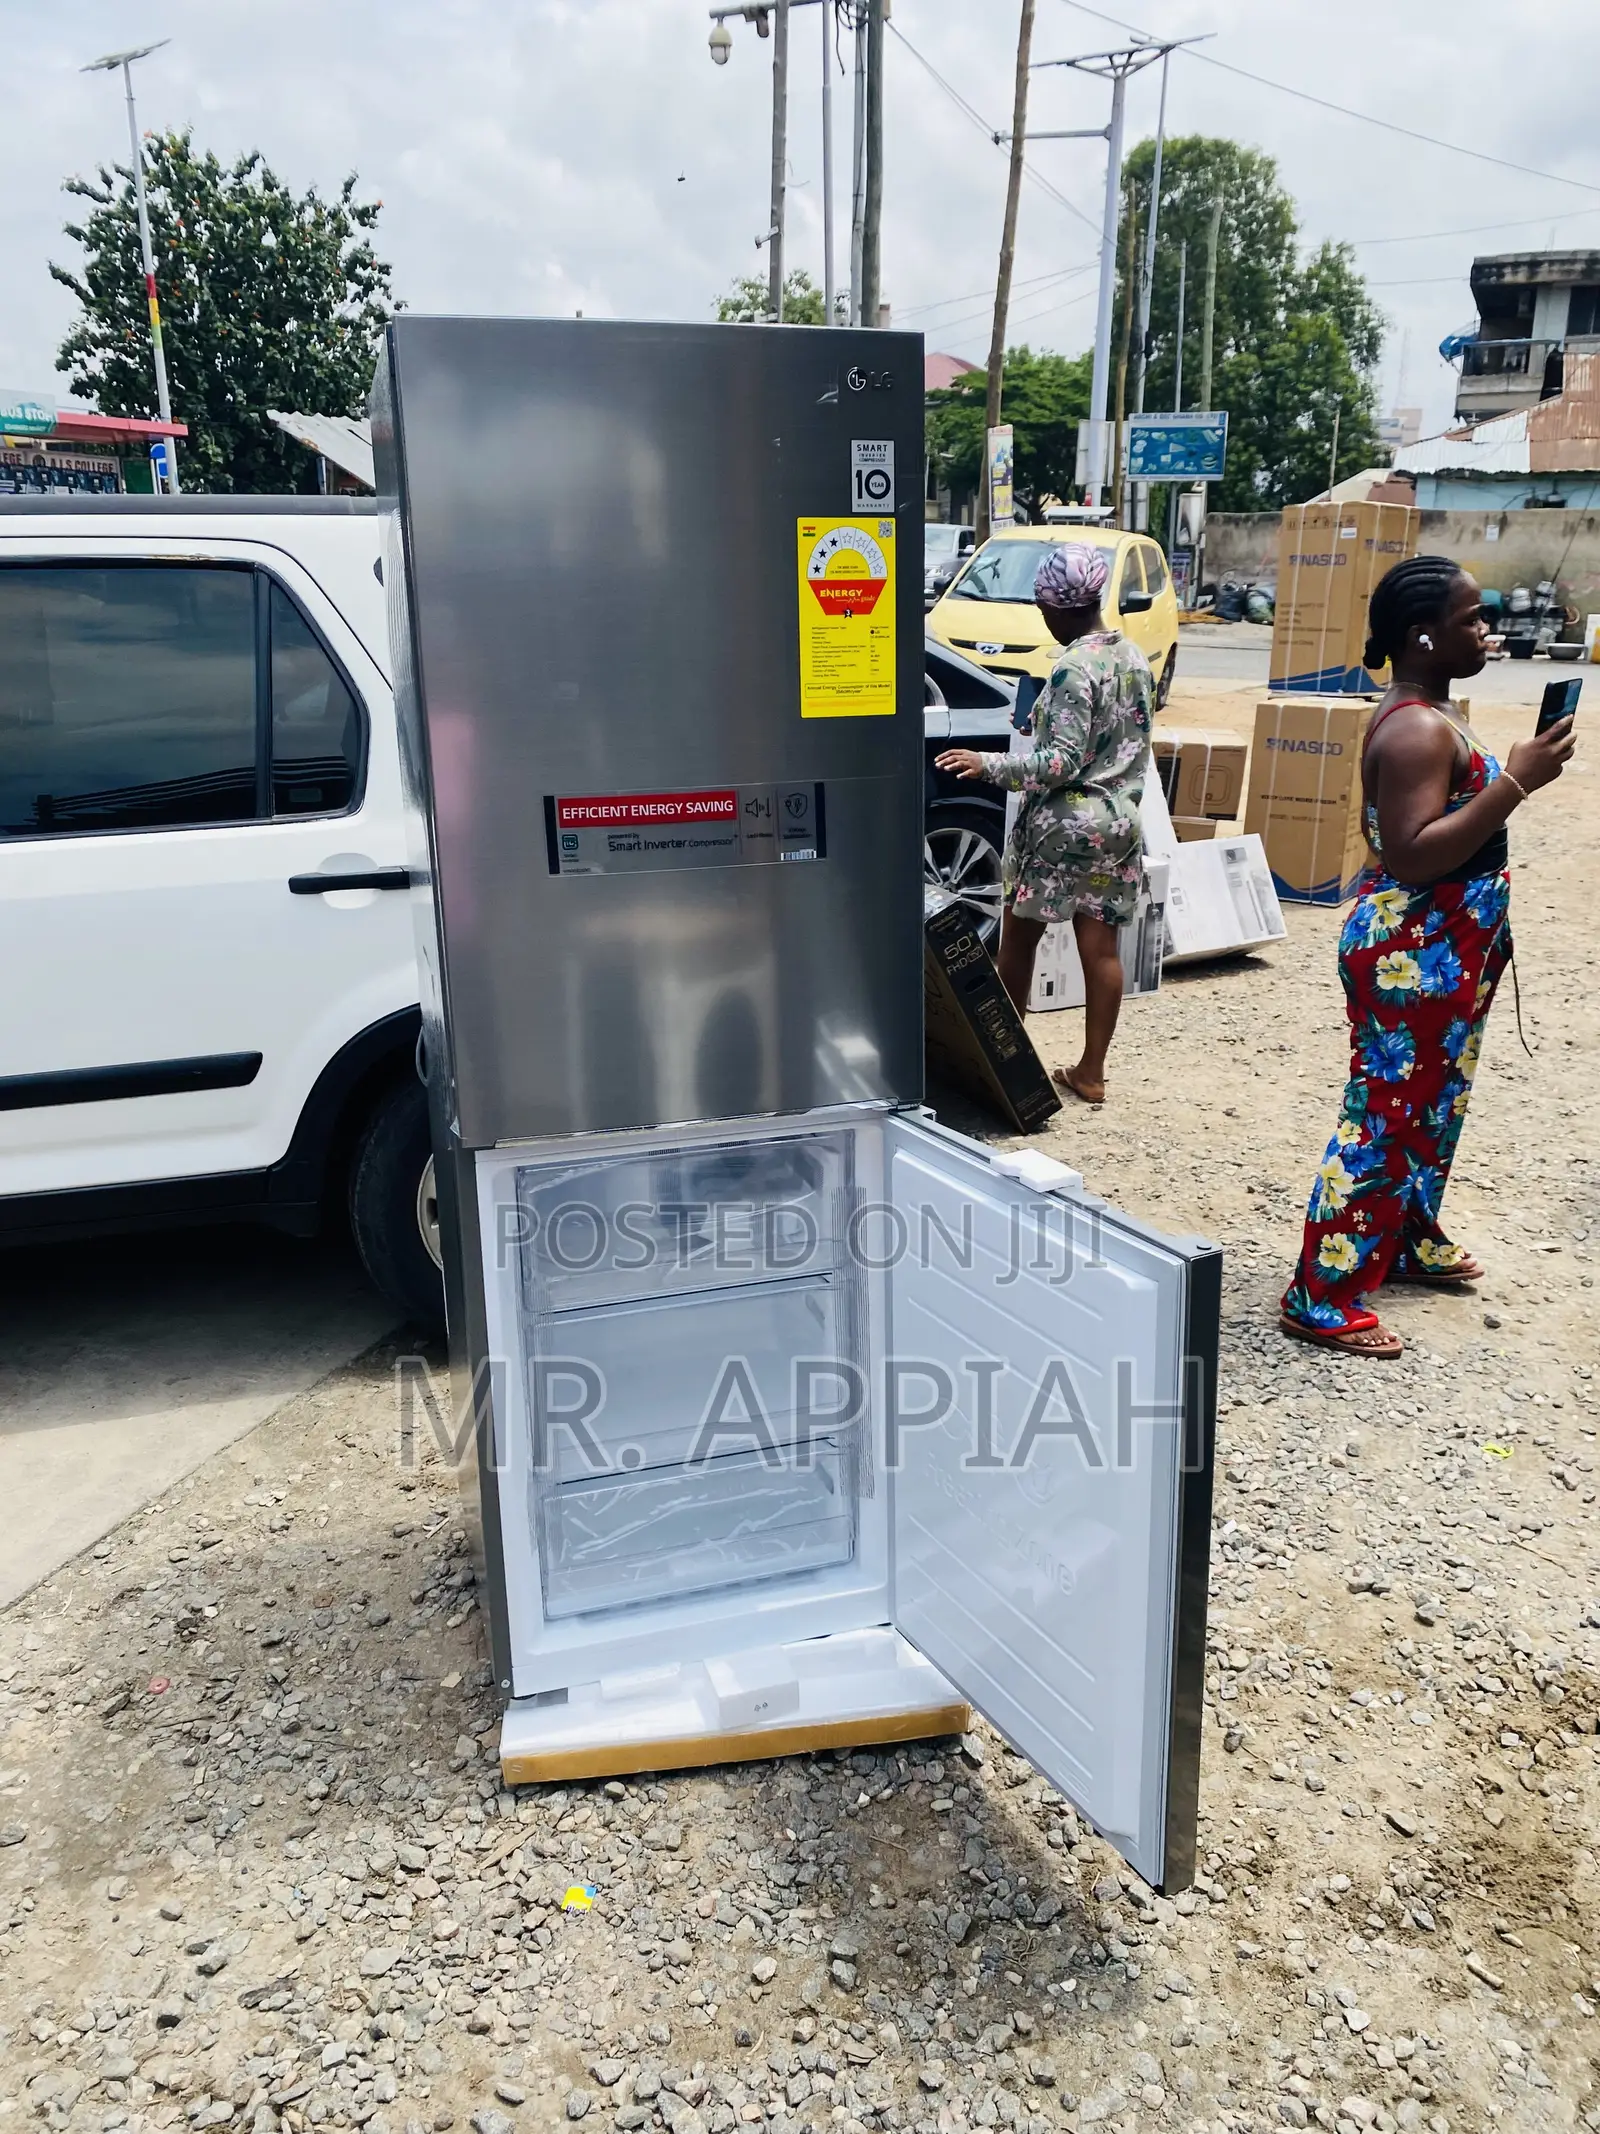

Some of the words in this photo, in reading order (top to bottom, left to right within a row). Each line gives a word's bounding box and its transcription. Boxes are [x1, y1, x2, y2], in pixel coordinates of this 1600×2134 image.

[856, 444, 888, 452] SMART
[855, 469, 891, 500] 10
[1301, 553, 1347, 566] NASCO
[820, 588, 863, 599] ENERGY
[1281, 739, 1344, 756] NASCO
[562, 805, 628, 820] EFFICIENT
[631, 802, 683, 816] ENERGY
[685, 800, 734, 814] SAVING
[608, 840, 642, 852] Smart
[644, 838, 686, 850] Inverter
